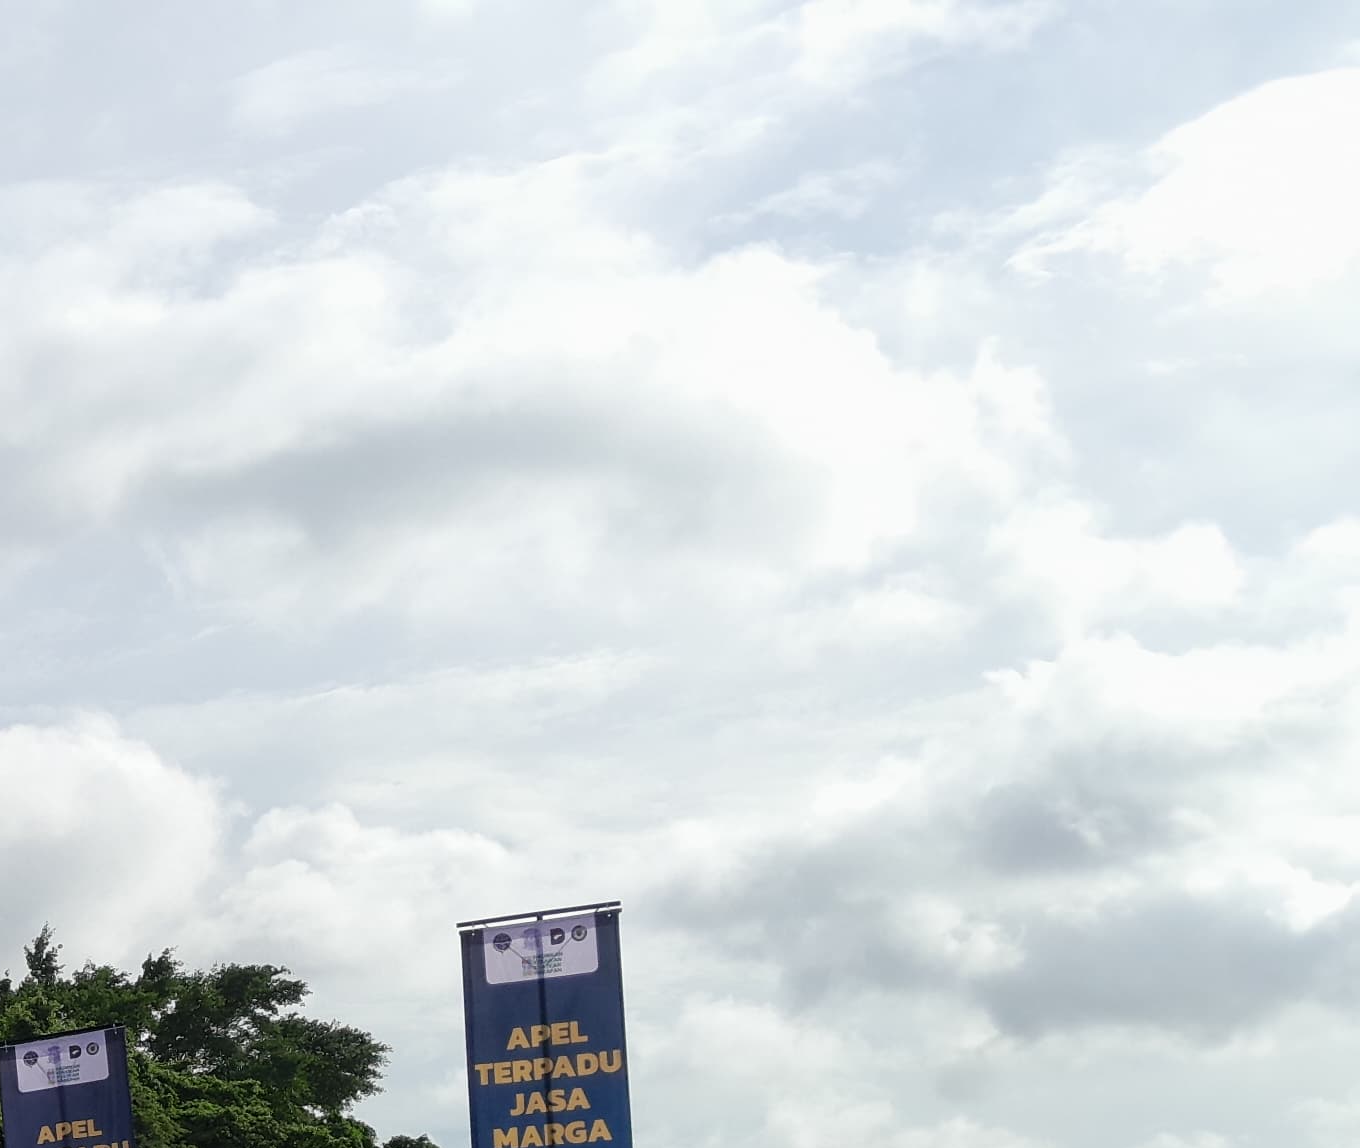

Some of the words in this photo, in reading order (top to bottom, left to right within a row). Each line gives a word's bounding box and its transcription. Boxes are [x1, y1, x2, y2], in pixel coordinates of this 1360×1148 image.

[506, 1020, 588, 1050] APEL
[474, 1049, 622, 1086] TERPADU
[510, 1087, 591, 1116] JASA
[37, 1119, 102, 1144] APEL
